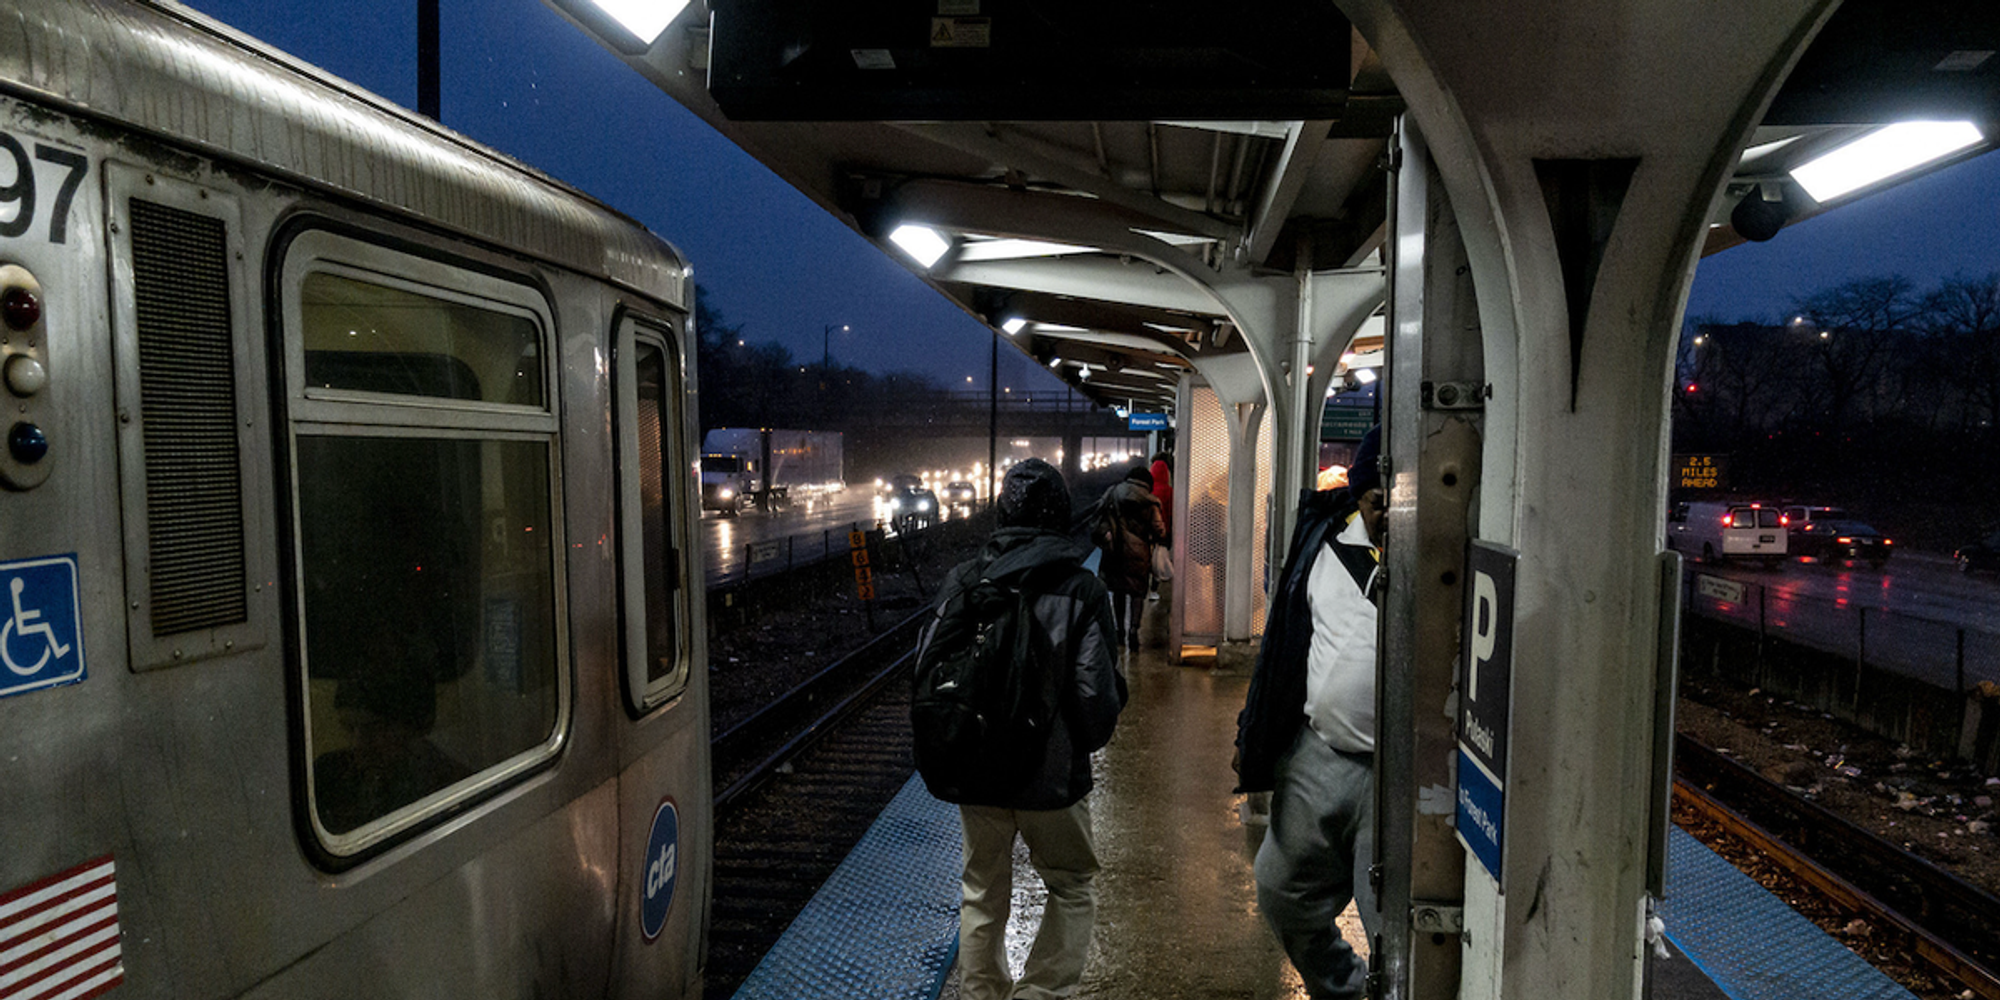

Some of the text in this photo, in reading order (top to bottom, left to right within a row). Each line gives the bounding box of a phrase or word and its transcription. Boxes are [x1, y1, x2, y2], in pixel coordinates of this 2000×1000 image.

[0, 131, 88, 244] 97
[1682, 467, 1718, 477] MILES
[1690, 457, 1711, 466] 2.5
[1682, 478, 1718, 488] AHEAD
[856, 552, 865, 564] 6
[859, 569, 868, 582] 4
[1469, 570, 1498, 702] P
[1465, 709, 1494, 760] Pulaski
[1464, 788, 1483, 829] Forest
[1482, 809, 1498, 846] Park
[646, 843, 676, 899] cta
